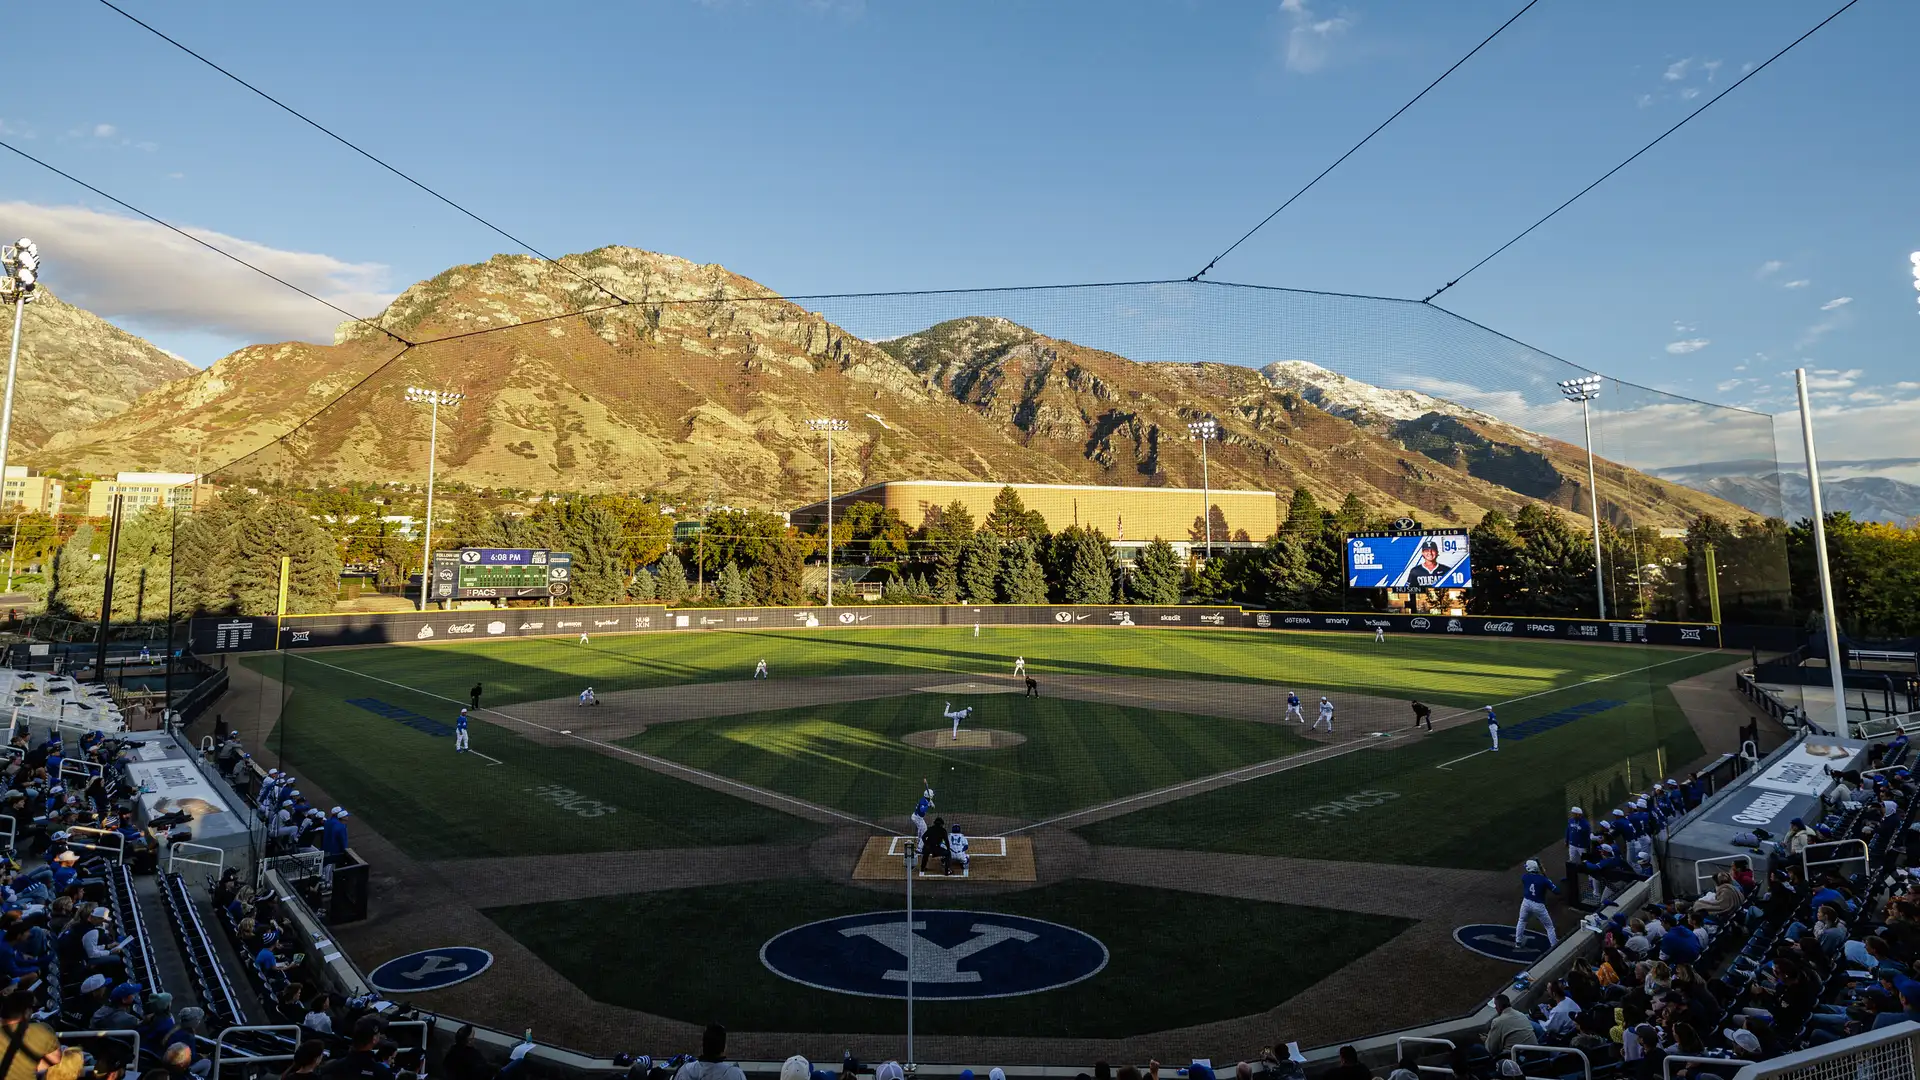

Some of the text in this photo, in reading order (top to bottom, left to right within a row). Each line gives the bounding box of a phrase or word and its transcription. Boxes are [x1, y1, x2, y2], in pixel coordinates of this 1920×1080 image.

[1399, 520, 1408, 528] Y
[1444, 540, 1457, 551] 94
[466, 553, 477, 561] Y
[1354, 554, 1374, 564] GOFF
[1452, 572, 1464, 584] 10
[544, 786, 617, 817] PACS
[1310, 789, 1401, 817] PACS
[1529, 883, 1536, 896] 4
[838, 920, 1040, 983] Y
[400, 955, 468, 981] Y
